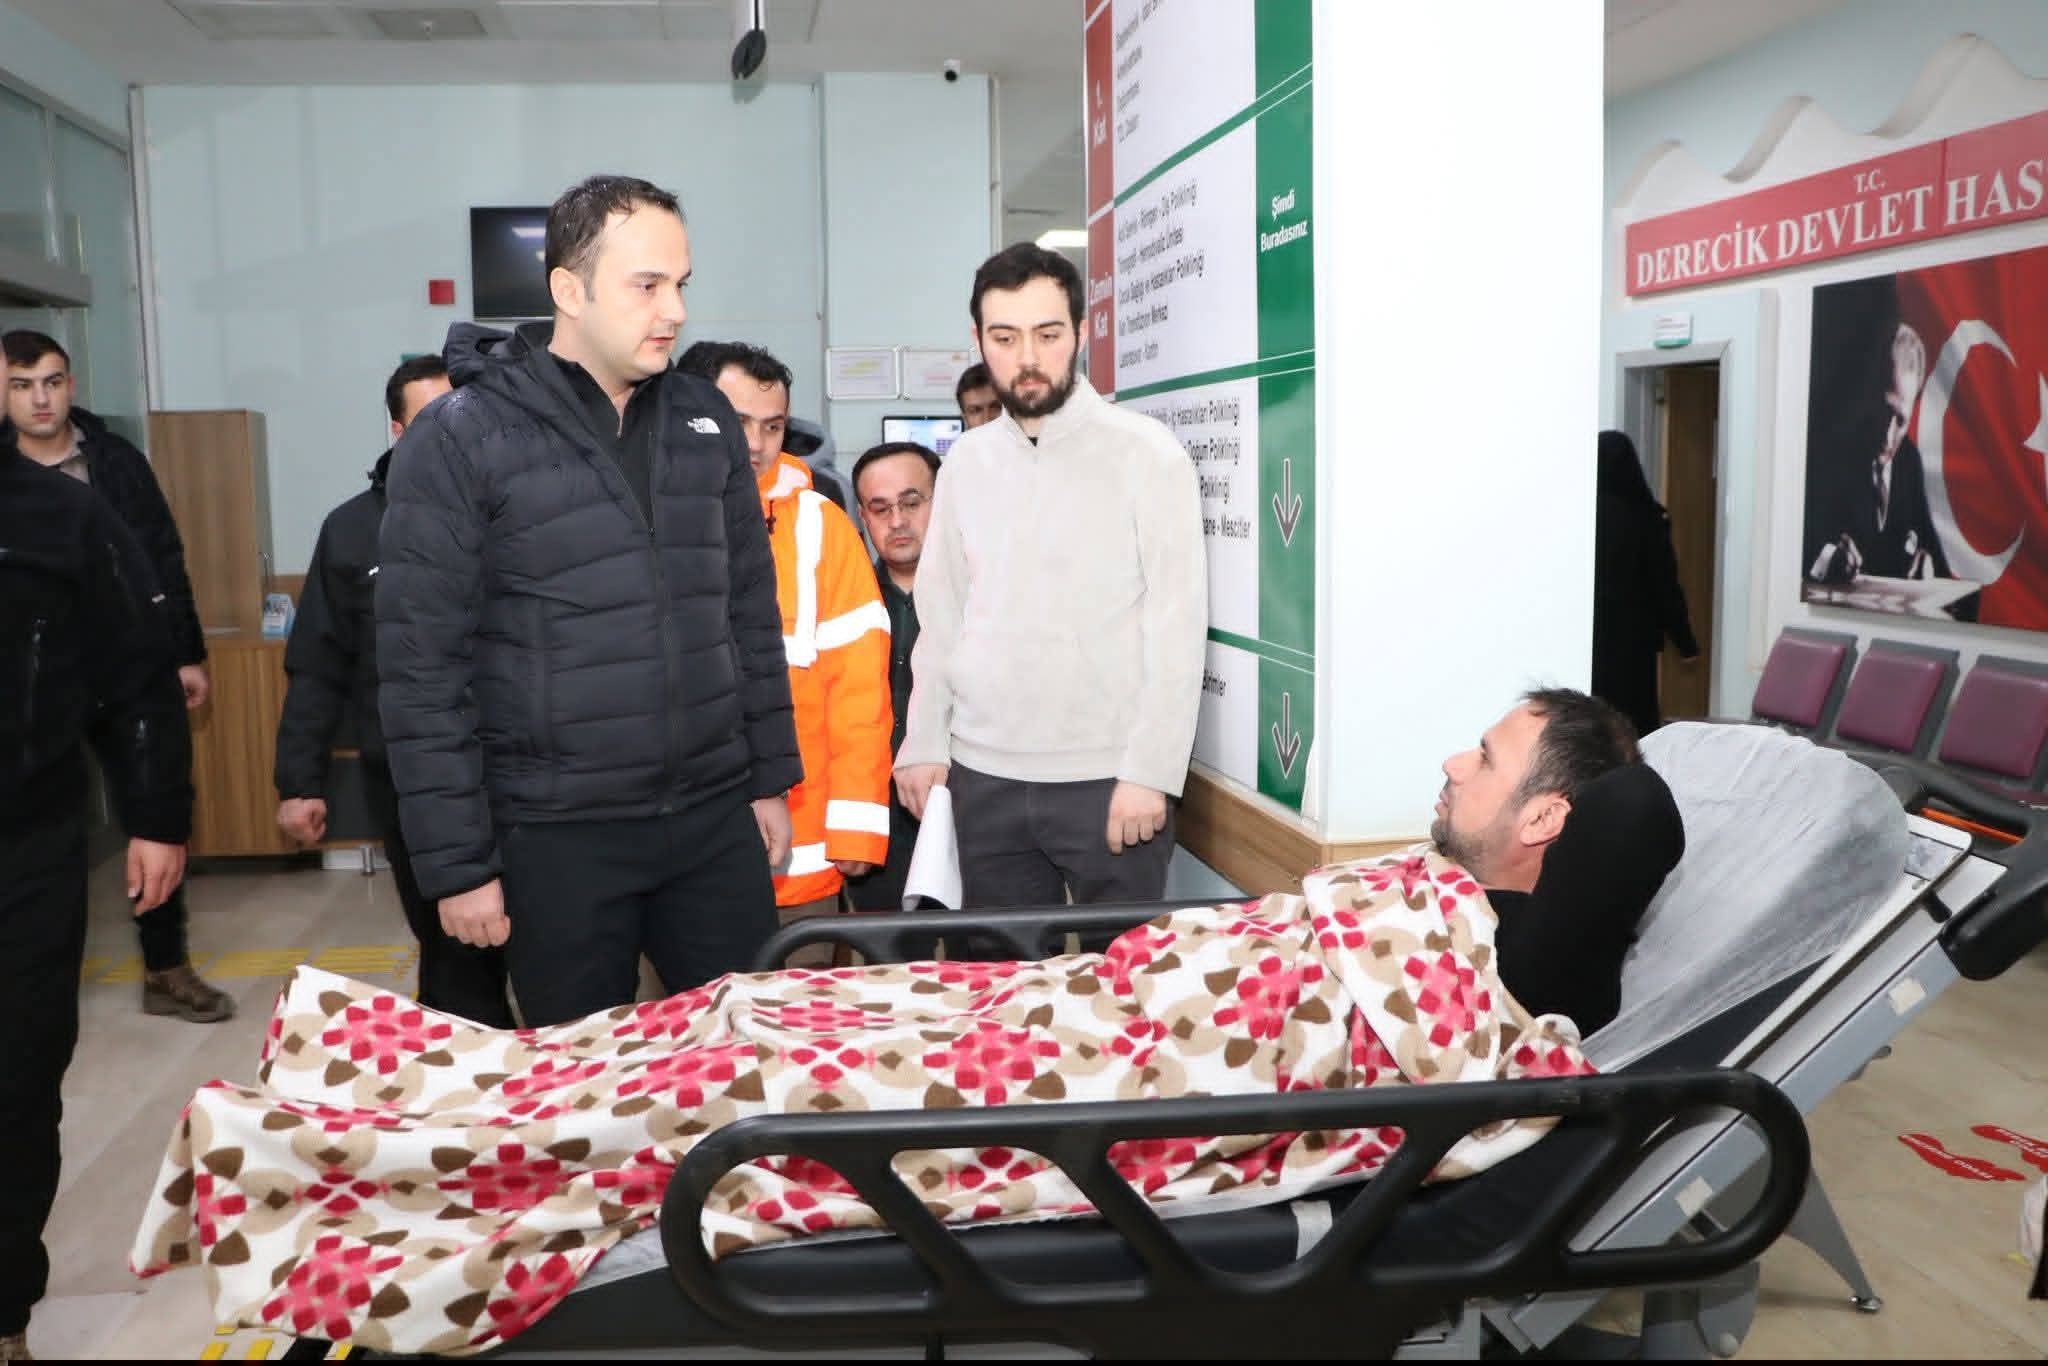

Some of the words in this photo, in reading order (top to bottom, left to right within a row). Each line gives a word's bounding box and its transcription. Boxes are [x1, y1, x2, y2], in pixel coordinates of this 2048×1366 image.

[1272, 188, 1295, 221] Şimdi
[1261, 220, 1308, 252] Buradasınız
[1636, 220, 1769, 289] DERECİK
[1776, 185, 1933, 260] DEVLET
[1944, 157, 2048, 227] HAS
[1209, 397, 1239, 426] Polikliniği
[1209, 436, 1240, 466] Polikliniği
[1200, 474, 1230, 505] Polikliniği
